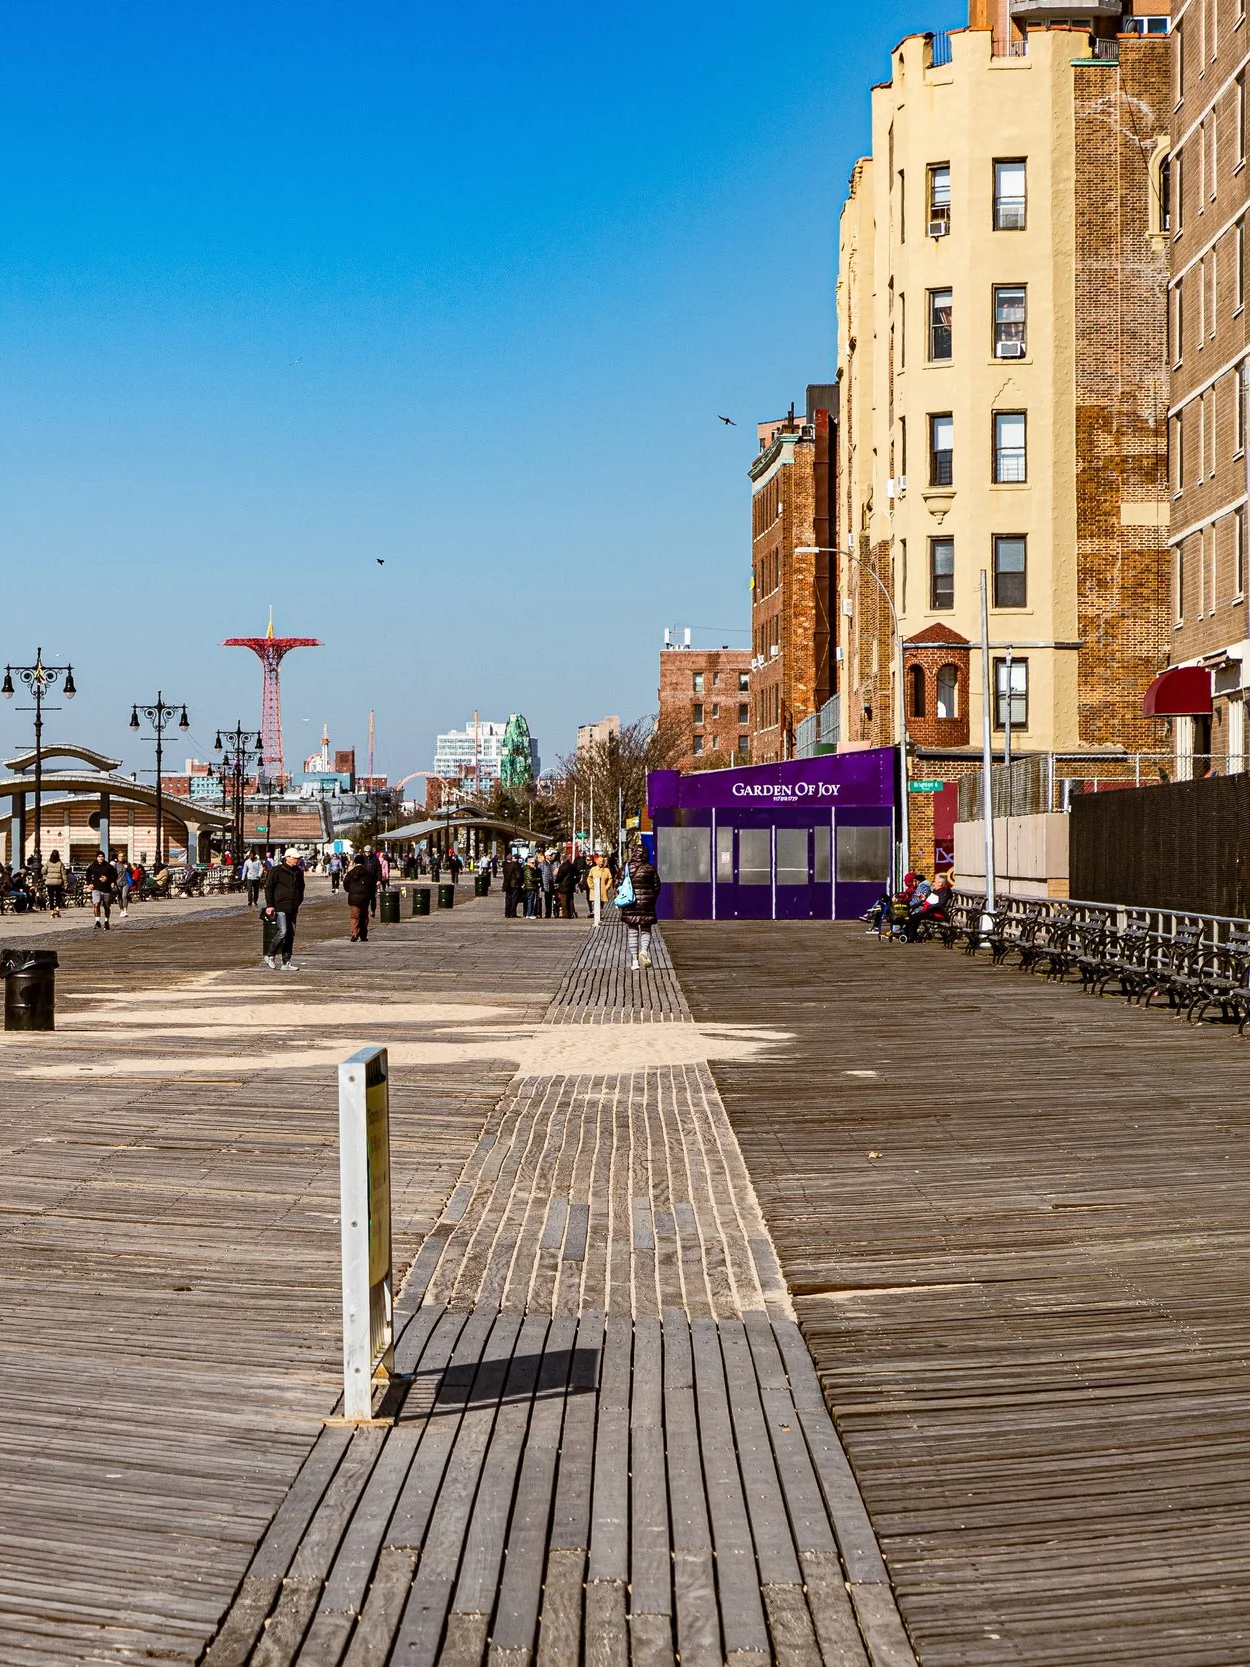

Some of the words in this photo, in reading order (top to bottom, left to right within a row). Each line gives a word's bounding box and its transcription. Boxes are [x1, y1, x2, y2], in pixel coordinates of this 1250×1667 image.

[732, 782, 793, 796] GARDEN
[795, 782, 816, 796] OF
[817, 782, 841, 797] JOY
